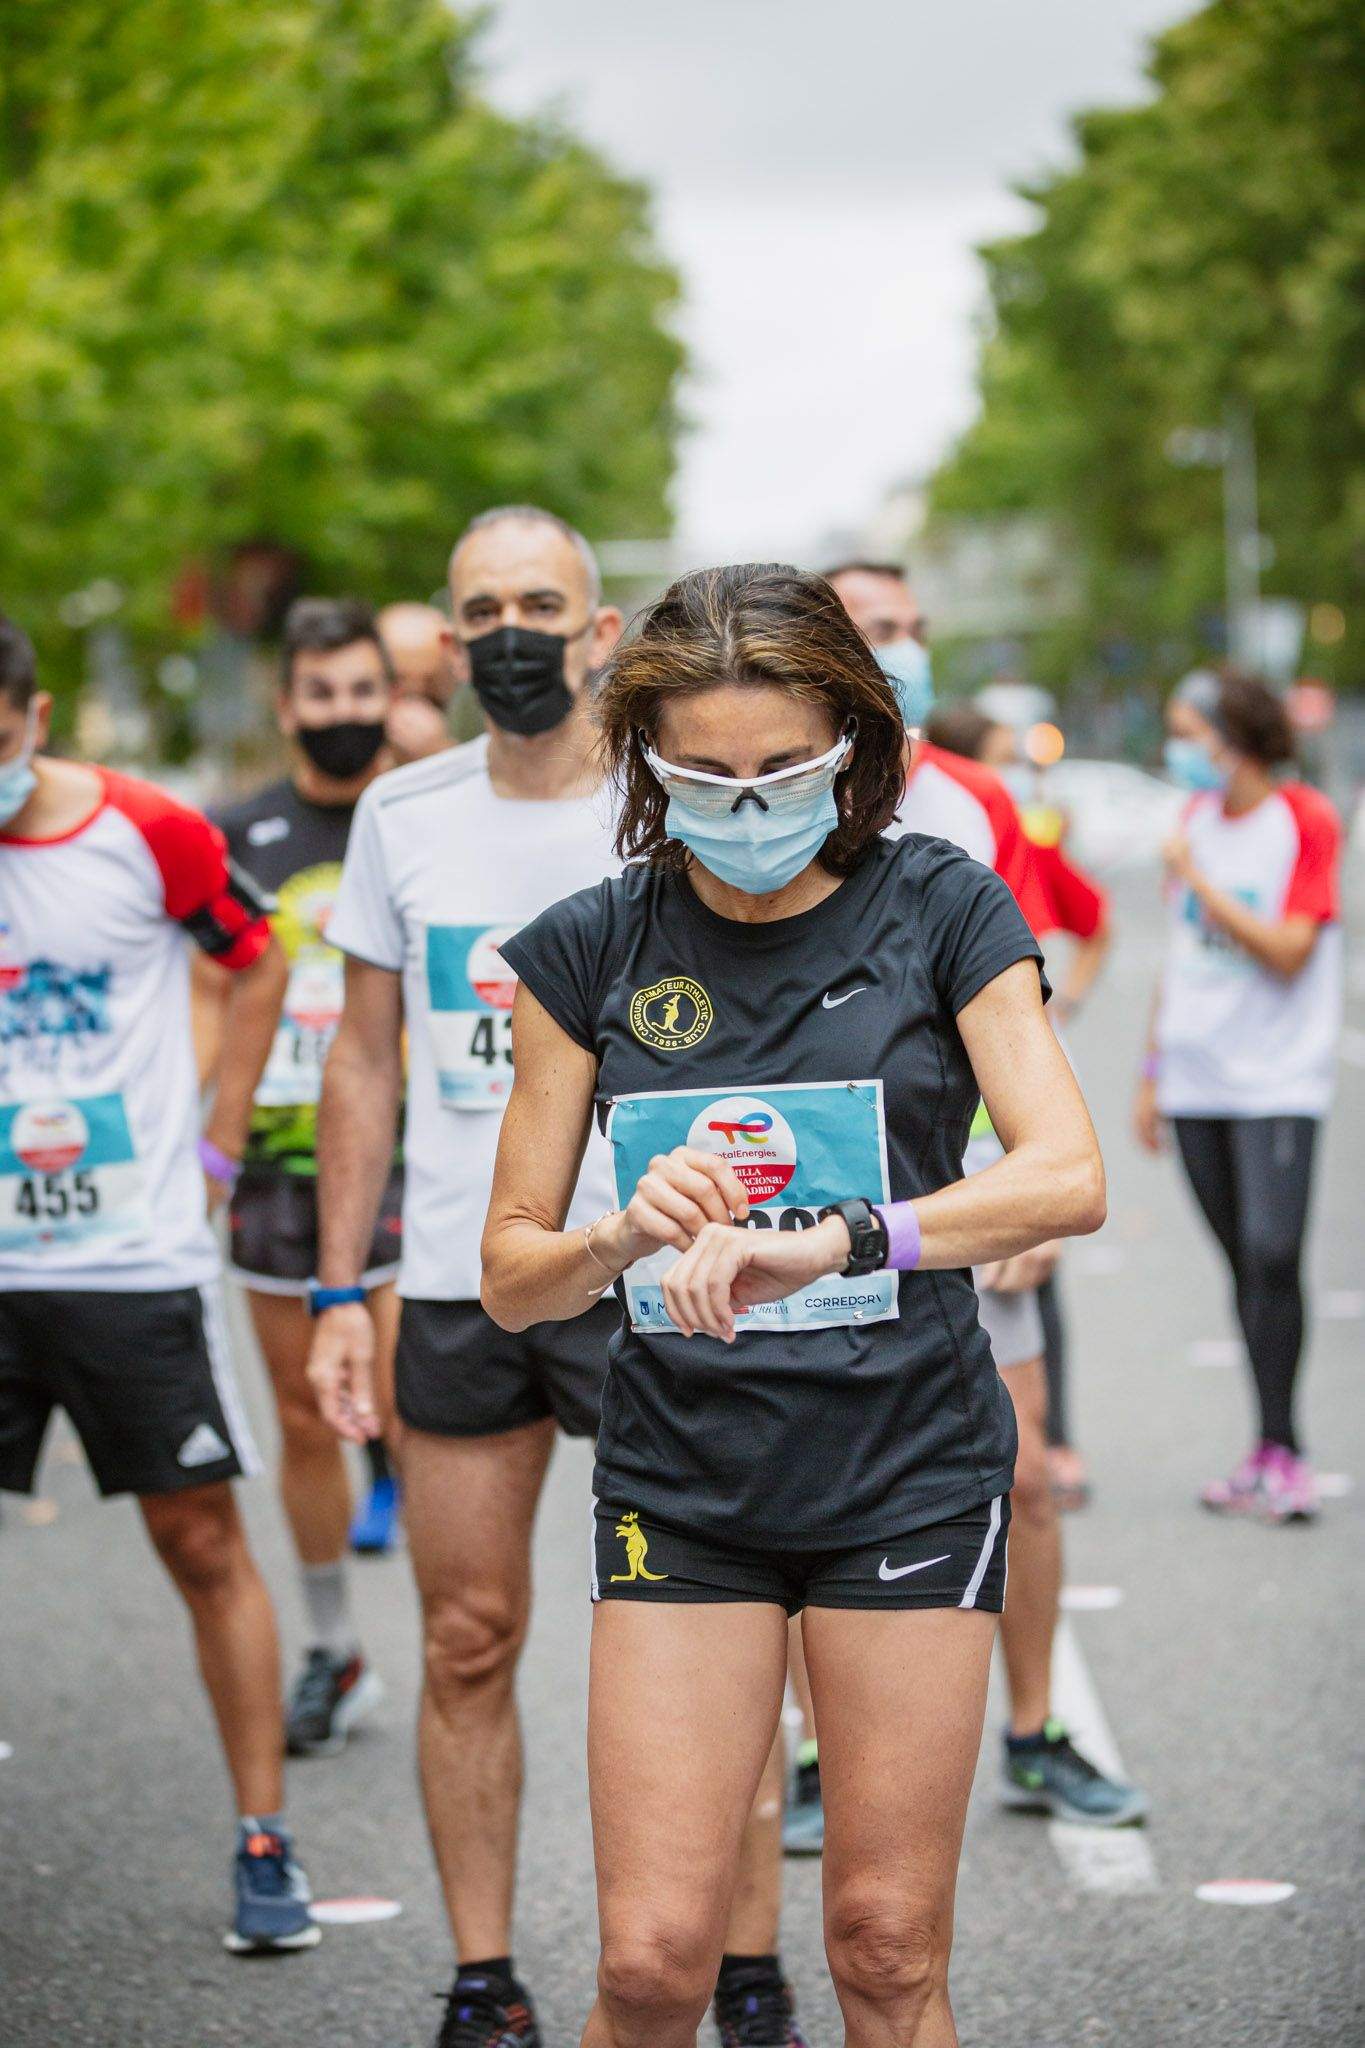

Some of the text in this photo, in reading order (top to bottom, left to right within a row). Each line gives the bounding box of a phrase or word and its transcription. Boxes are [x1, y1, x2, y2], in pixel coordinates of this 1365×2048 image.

[633, 981, 709, 1044] CANGURO AMATEUR ATHLETIC CLUB
[713, 1148, 777, 1159] talEnergies
[16, 1172, 98, 1218] 455
[747, 1185, 775, 1195] ADRID
